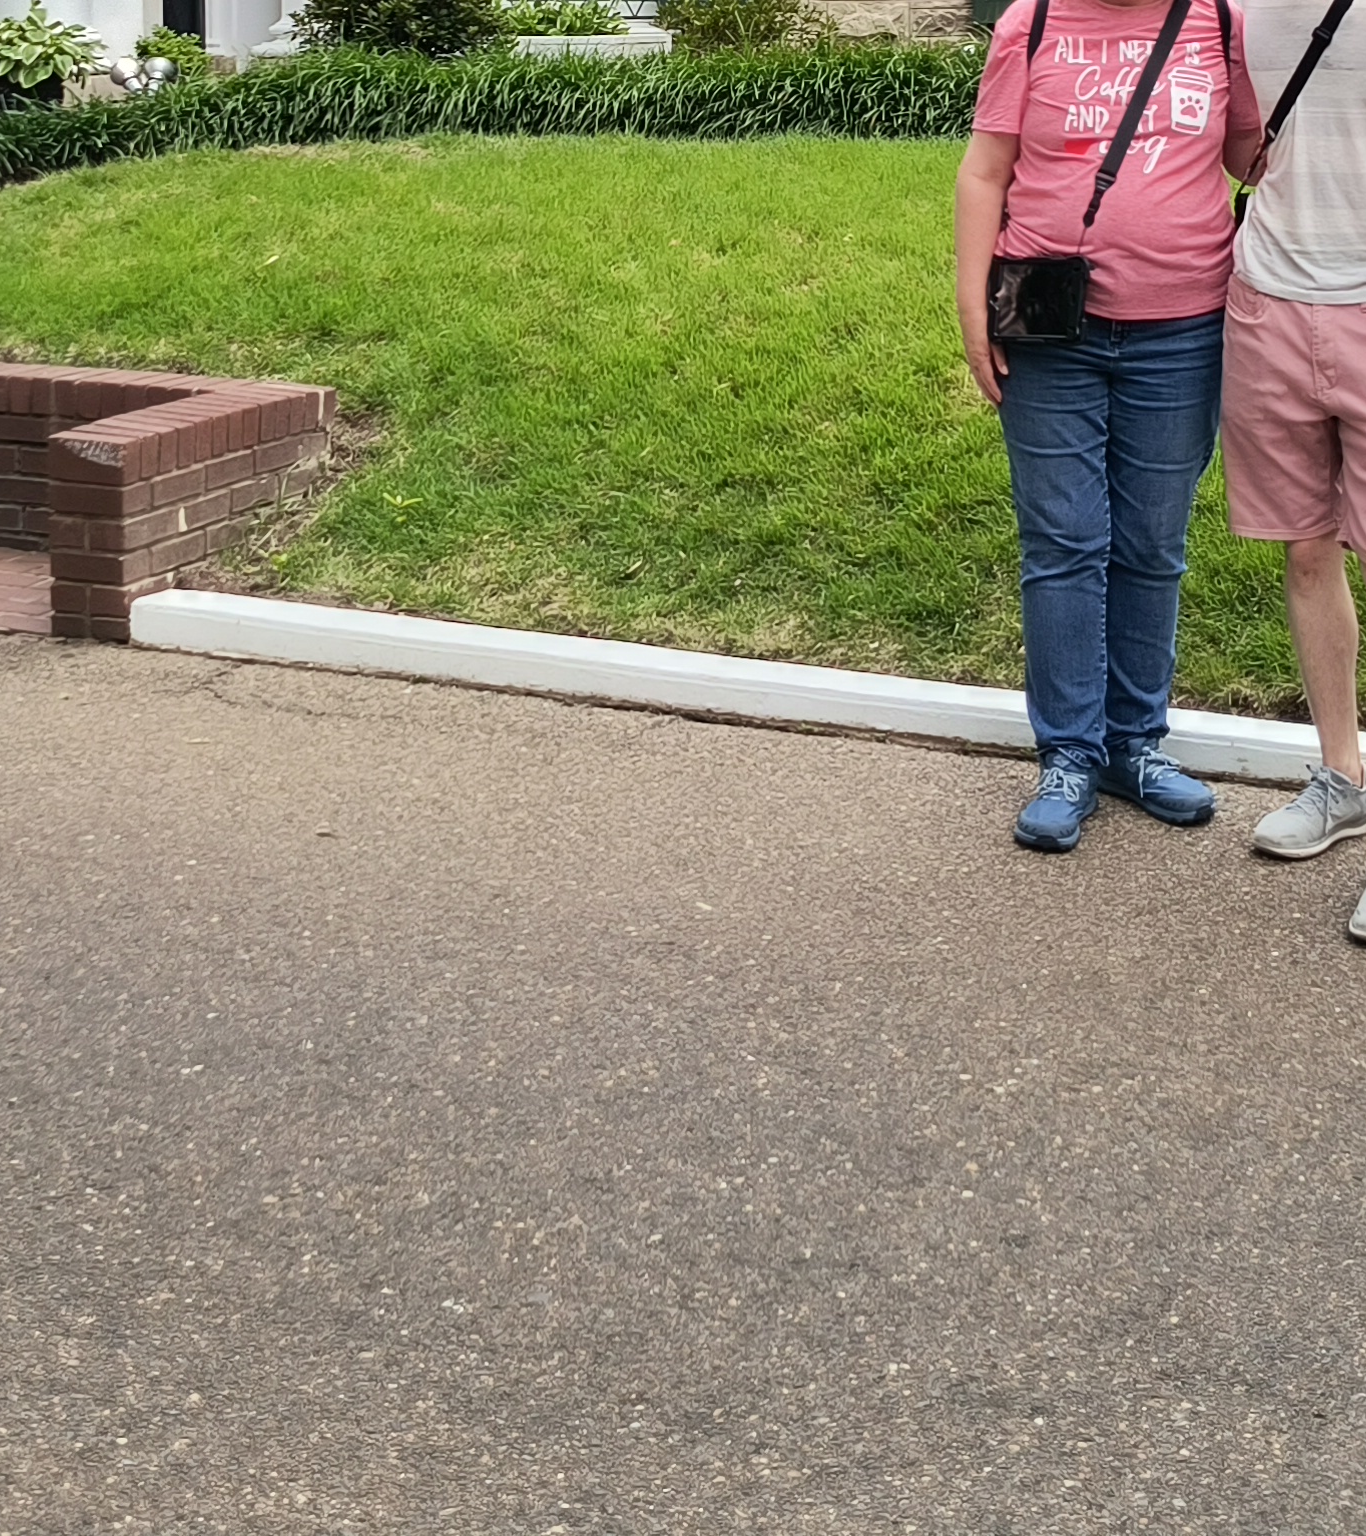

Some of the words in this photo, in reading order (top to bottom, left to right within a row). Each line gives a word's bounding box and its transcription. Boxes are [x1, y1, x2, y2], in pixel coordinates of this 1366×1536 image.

[1054, 36, 1093, 63] ALL
[1101, 39, 1108, 63] I
[1184, 41, 1201, 64] IS
[1064, 104, 1110, 134] AND
